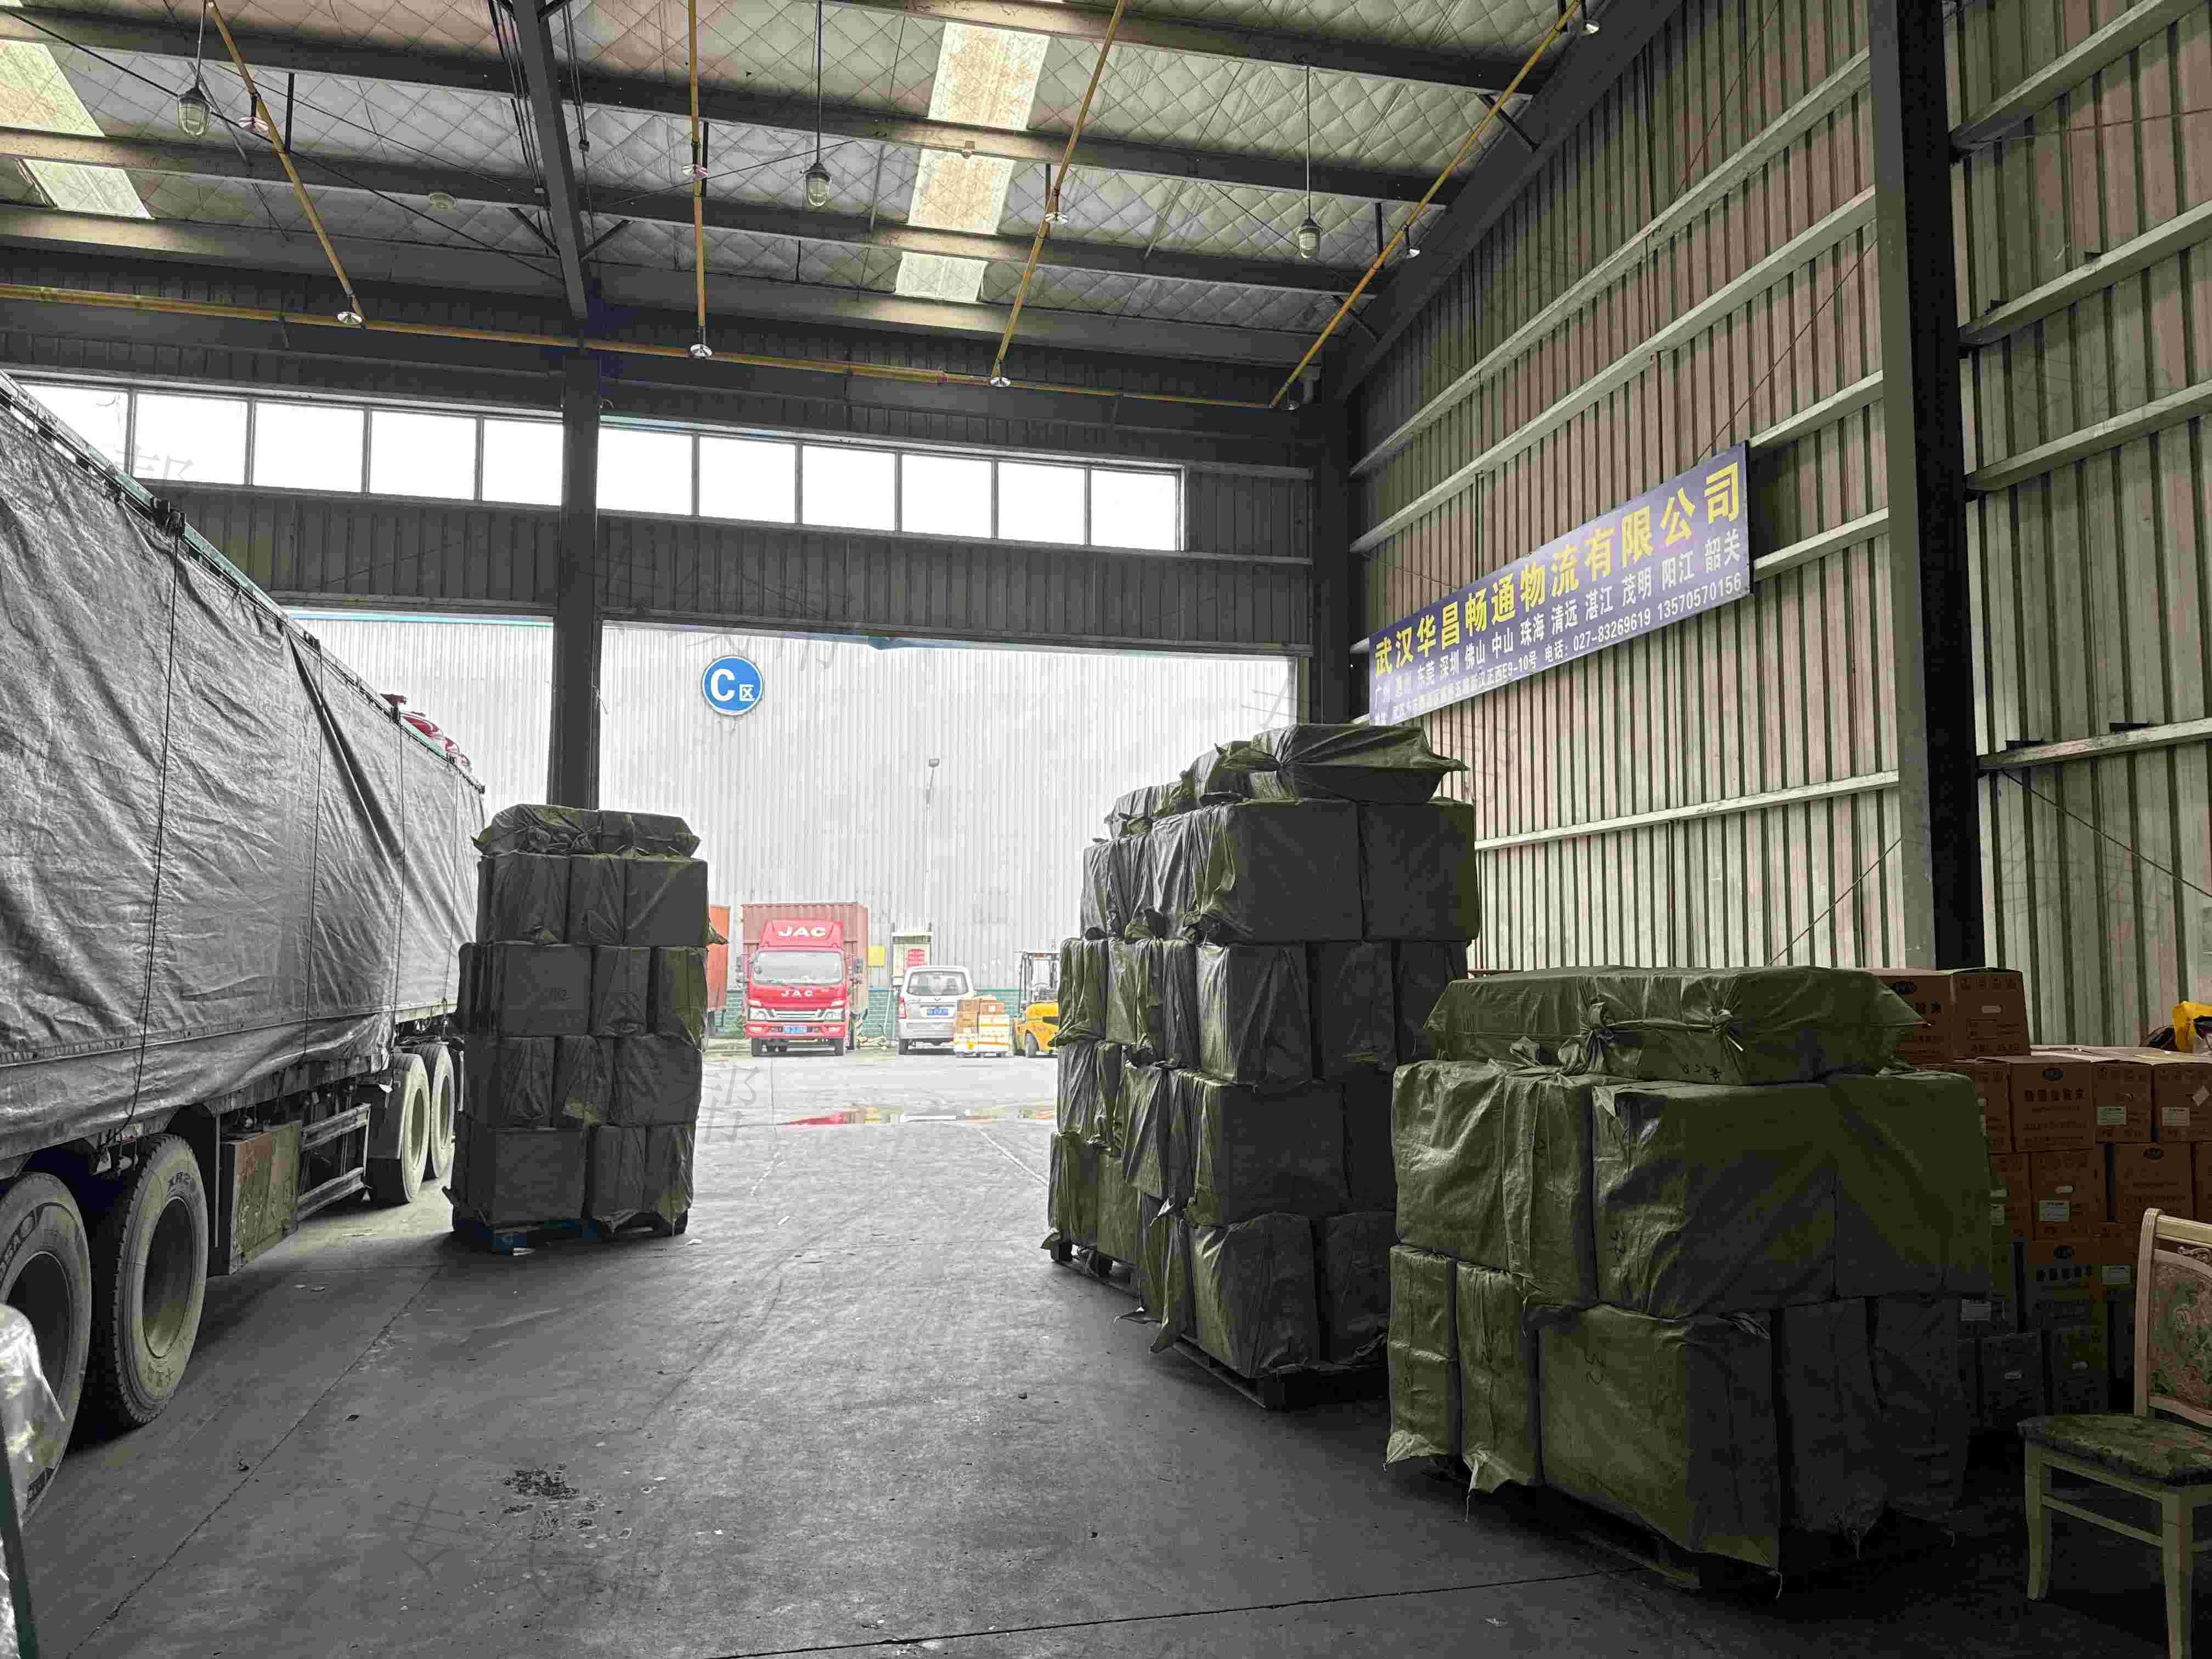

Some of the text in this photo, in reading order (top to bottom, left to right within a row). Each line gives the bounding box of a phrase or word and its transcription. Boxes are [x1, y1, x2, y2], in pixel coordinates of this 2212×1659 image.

[1374, 461, 1740, 678] 武汉华昌畅通物流有限公司
[1375, 681, 1390, 709] 广州
[1418, 660, 1436, 689] 东莞
[1440, 649, 1459, 680] 深圳
[1465, 639, 1486, 670] 佛山
[1492, 628, 1514, 659] 中山
[1520, 613, 1545, 647] 珠海
[1550, 599, 1579, 635] 清远
[1584, 585, 1613, 620] 湛江
[1622, 568, 1652, 605] 茂明
[1661, 550, 1695, 590] 阳江
[1704, 528, 1741, 574] 韶关
[1573, 608, 1652, 652] 027-83269619
[1658, 572, 1742, 620] 13570570156
[777, 926, 827, 938] JAC
